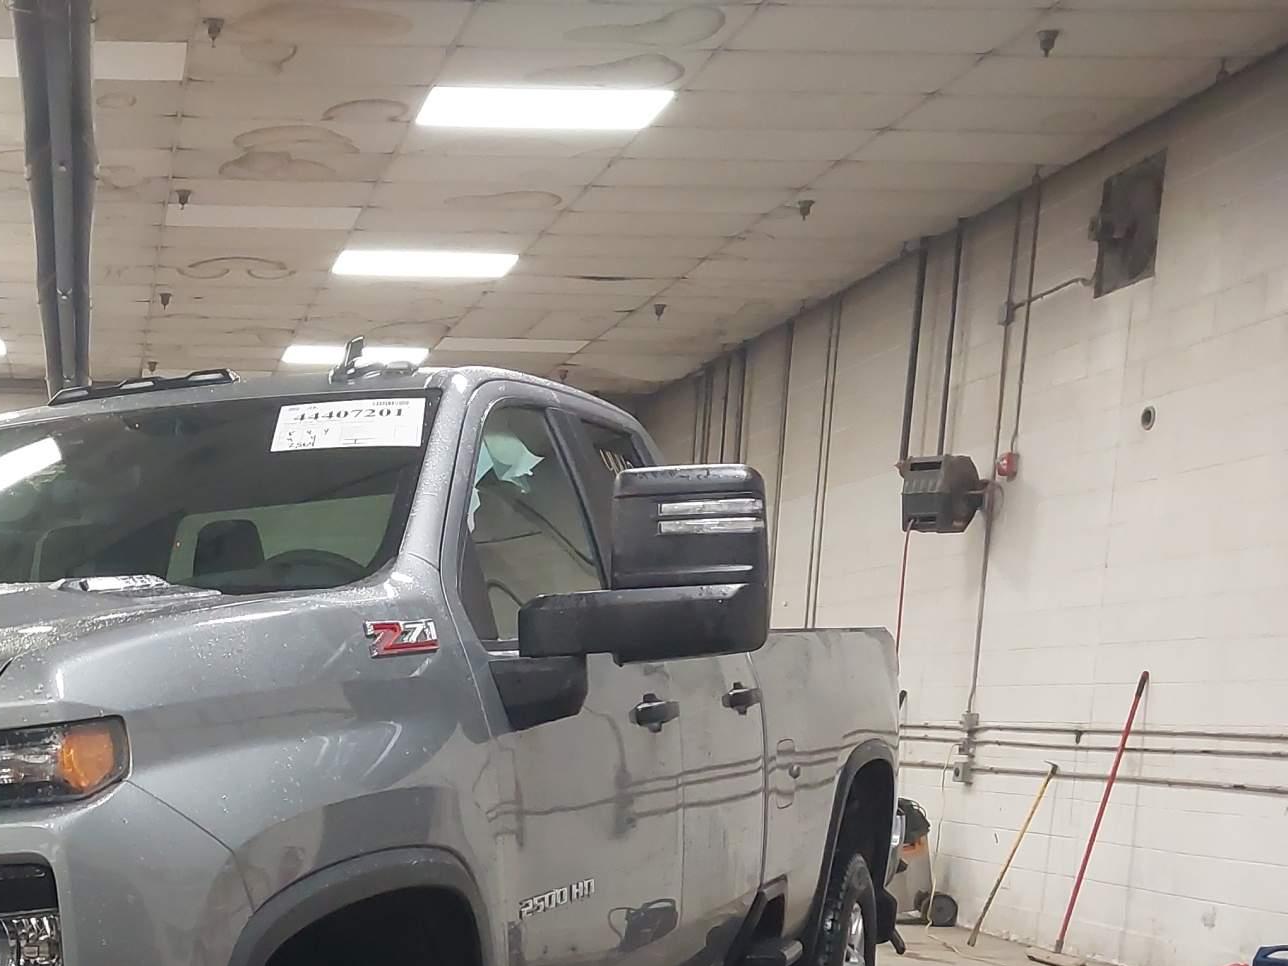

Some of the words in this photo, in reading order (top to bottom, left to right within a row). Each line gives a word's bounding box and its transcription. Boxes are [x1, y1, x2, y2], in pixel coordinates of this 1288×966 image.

[293, 408, 403, 421] 44407201
[363, 618, 440, 658] Z71
[519, 887, 568, 919] 2500
